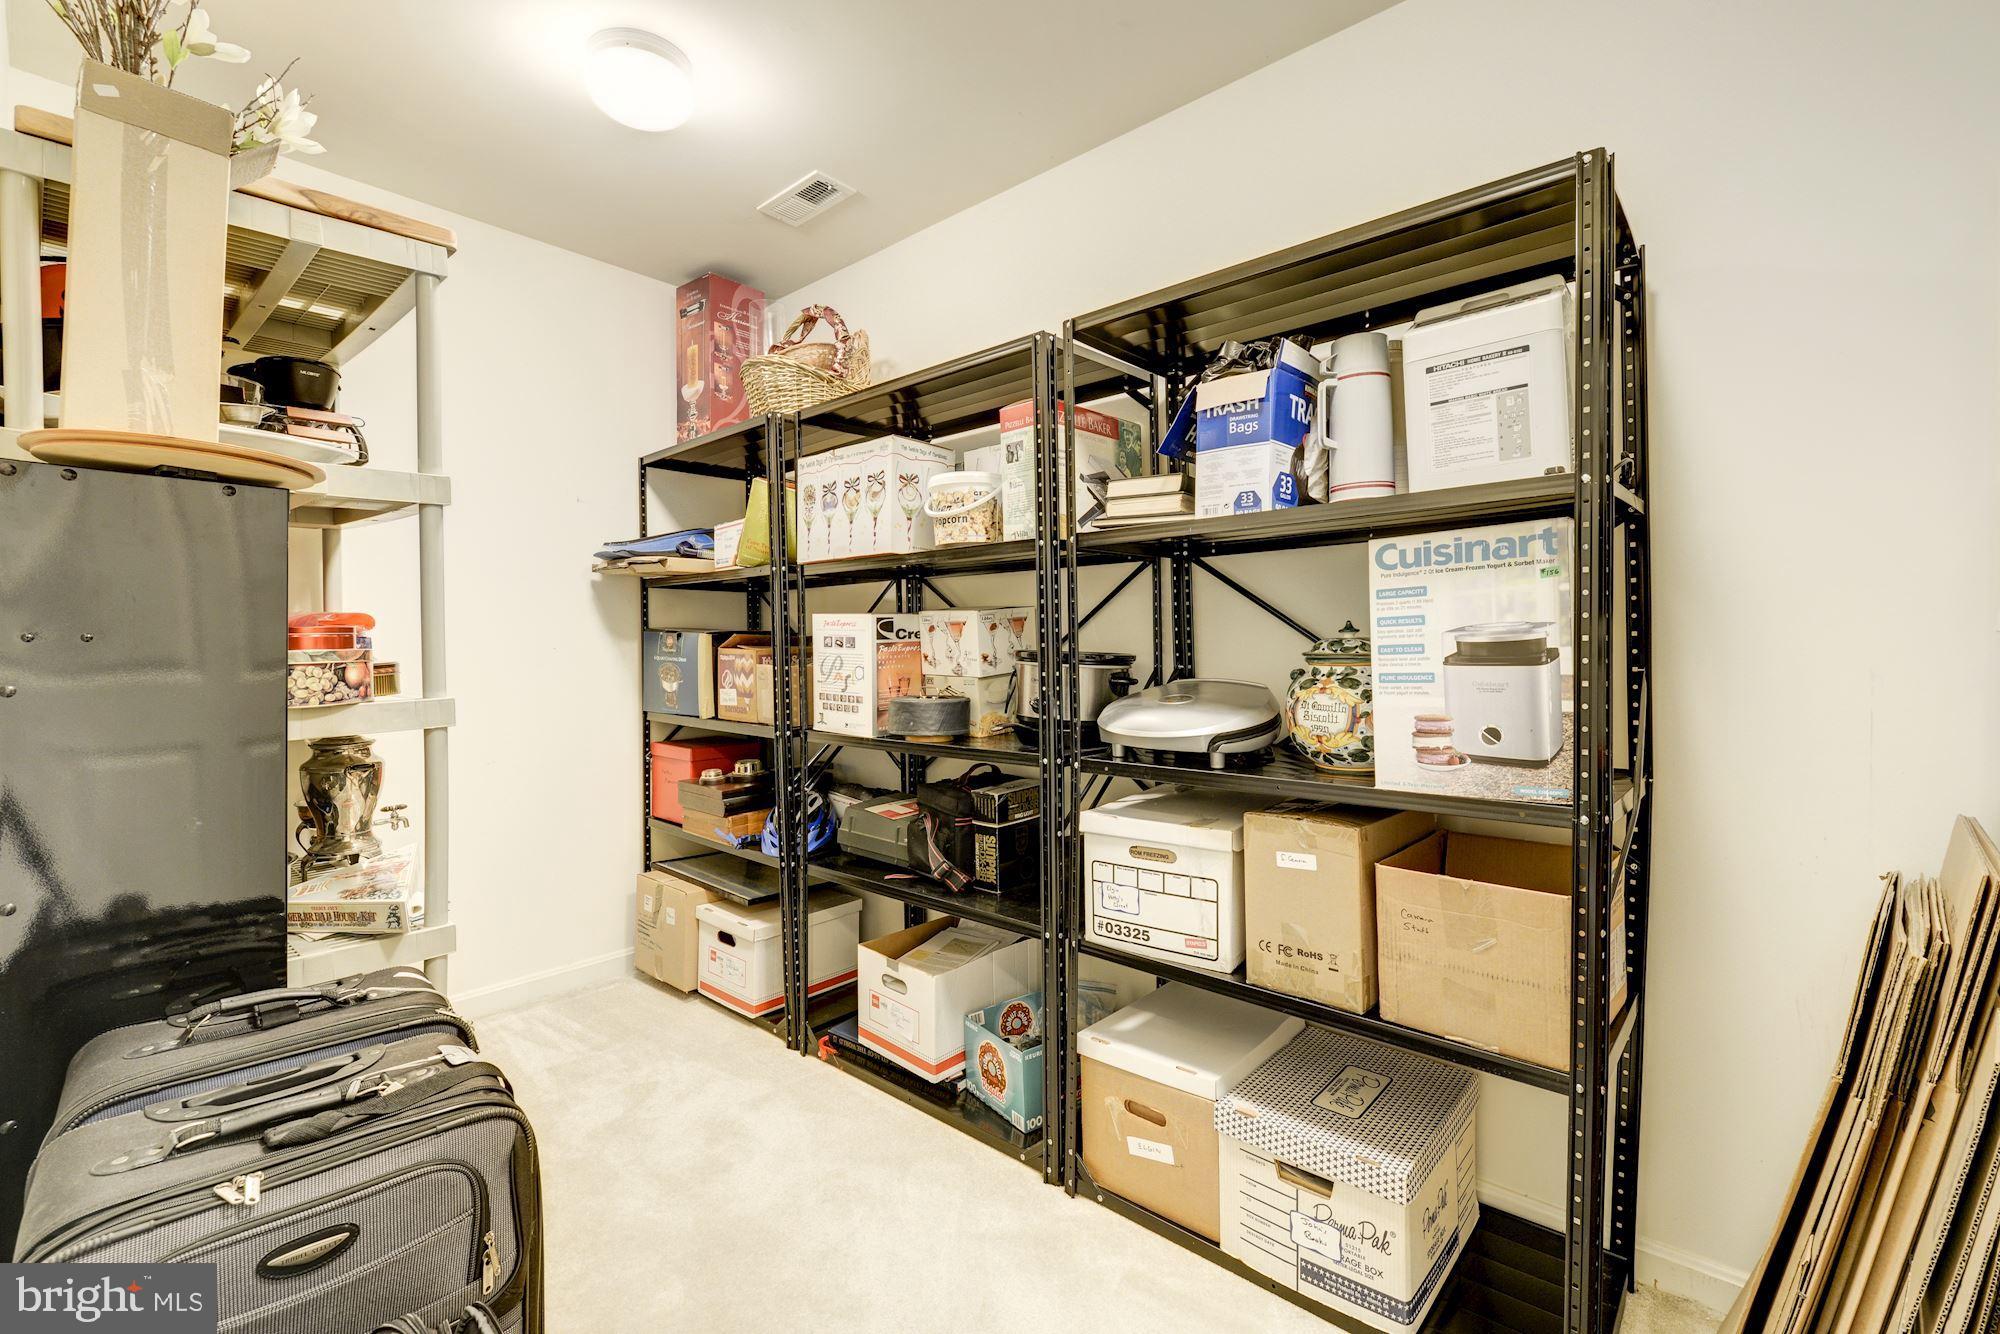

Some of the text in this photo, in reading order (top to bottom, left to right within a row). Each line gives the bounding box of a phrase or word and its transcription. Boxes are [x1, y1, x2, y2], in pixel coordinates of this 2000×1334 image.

[1433, 359, 1465, 373] HITACHI
[1482, 351, 1501, 361] BAKERY
[1088, 416, 1113, 436] BAKER
[1229, 421, 1259, 434] Bags
[1279, 474, 1293, 495] 33
[1240, 492, 1254, 504] 33
[1374, 526, 1559, 571] Cuisinart
[1486, 562, 1506, 571] Yogurt
[1513, 559, 1535, 567] Sorbet
[1378, 587, 1425, 597] LARGE CAPACITY
[1379, 618, 1397, 626] QUICK
[1311, 701, 1347, 714] Camillo
[1302, 710, 1341, 724] Biscotti
[1007, 787, 1039, 806] SUNPAK
[986, 835, 997, 885] SUNPAK
[1130, 848, 1169, 860] ROM FREEZING
[1097, 920, 1151, 942] #03325
[1258, 939, 1272, 953] CE
[1296, 947, 1324, 961] RoHS
[1275, 959, 1292, 969] Made
[1300, 965, 1319, 976] China
[1005, 1010, 1029, 1032] DONUT SHOP
[1024, 1049, 1043, 1061] KEURI
[1026, 1115, 1043, 1130] 100
[1343, 1248, 1366, 1261] ORTABLE
[1340, 1254, 1385, 1279] RAGE BOX
[1348, 1266, 1375, 1281] LEGAL SIZE
